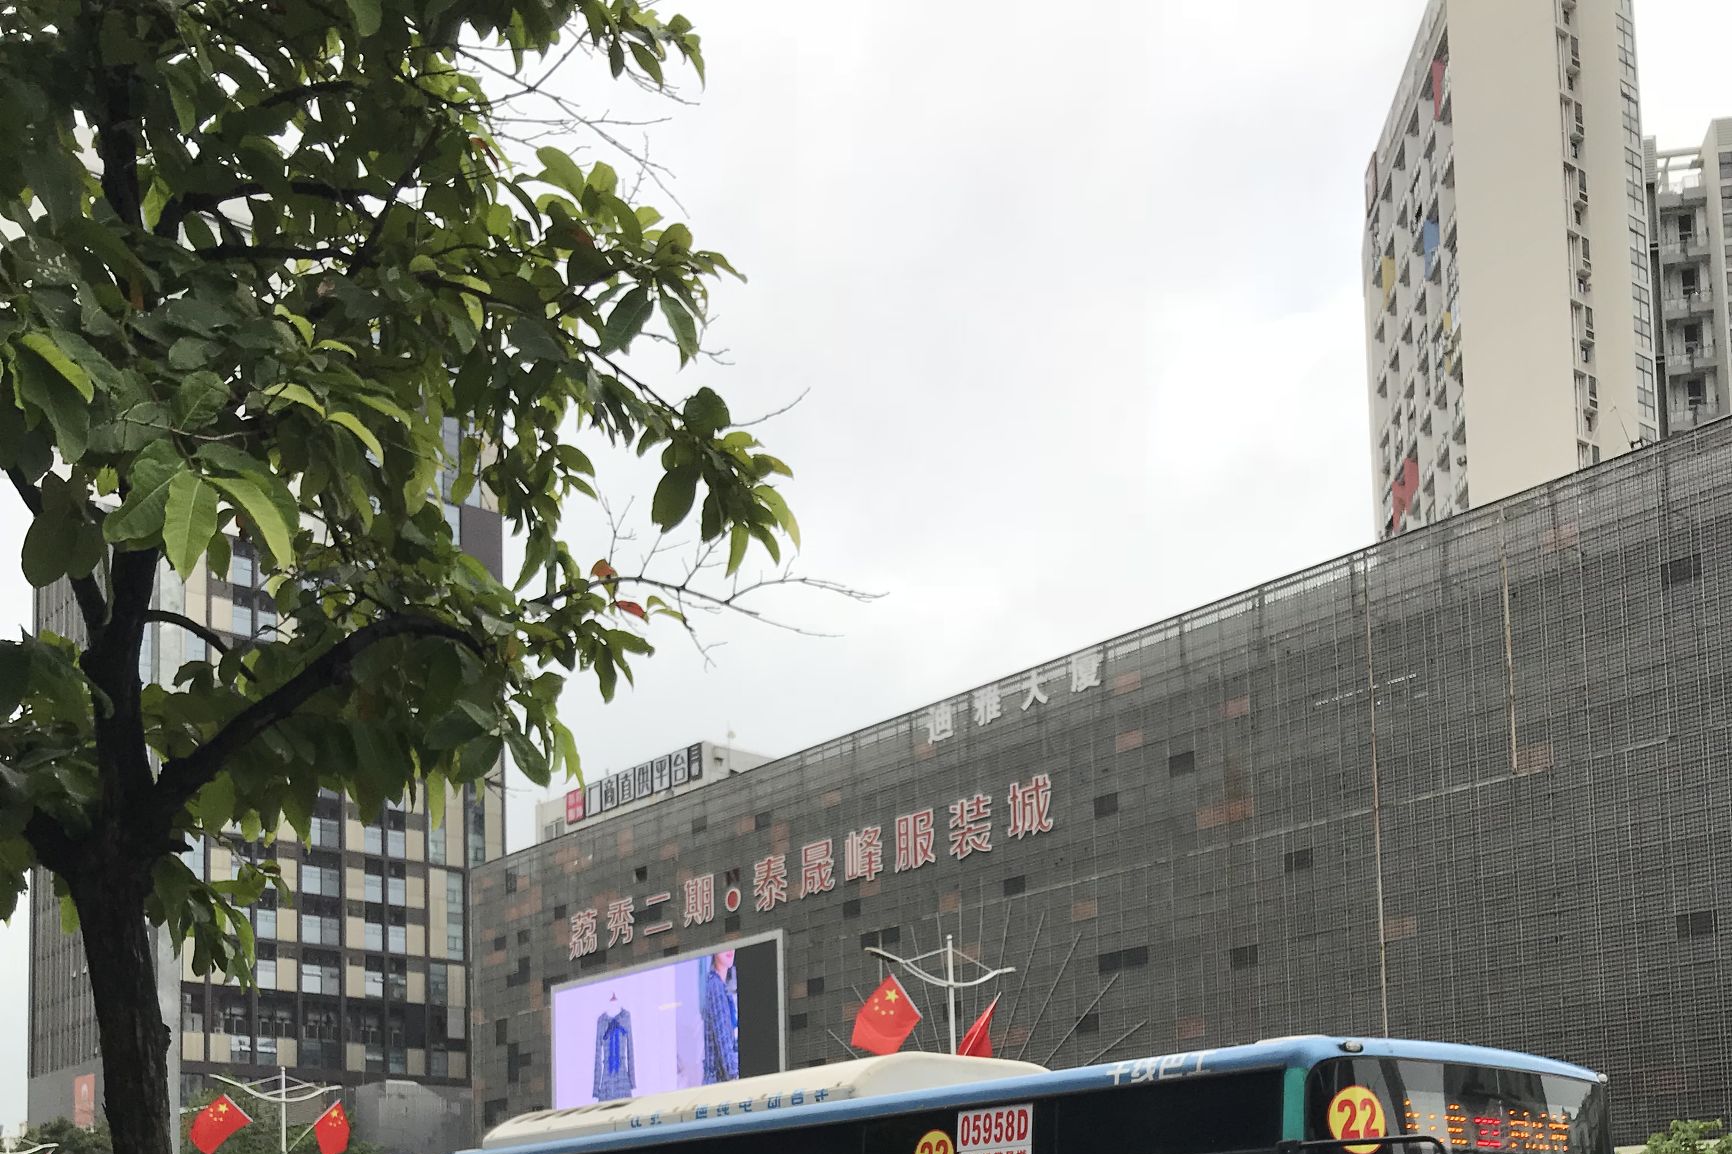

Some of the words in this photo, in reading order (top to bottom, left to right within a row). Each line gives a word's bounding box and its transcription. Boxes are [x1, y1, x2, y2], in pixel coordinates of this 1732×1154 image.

[587, 752, 686, 814] 厂商直供平台
[961, 1109, 1030, 1147] 05958D
[1337, 1097, 1380, 1140] 22
